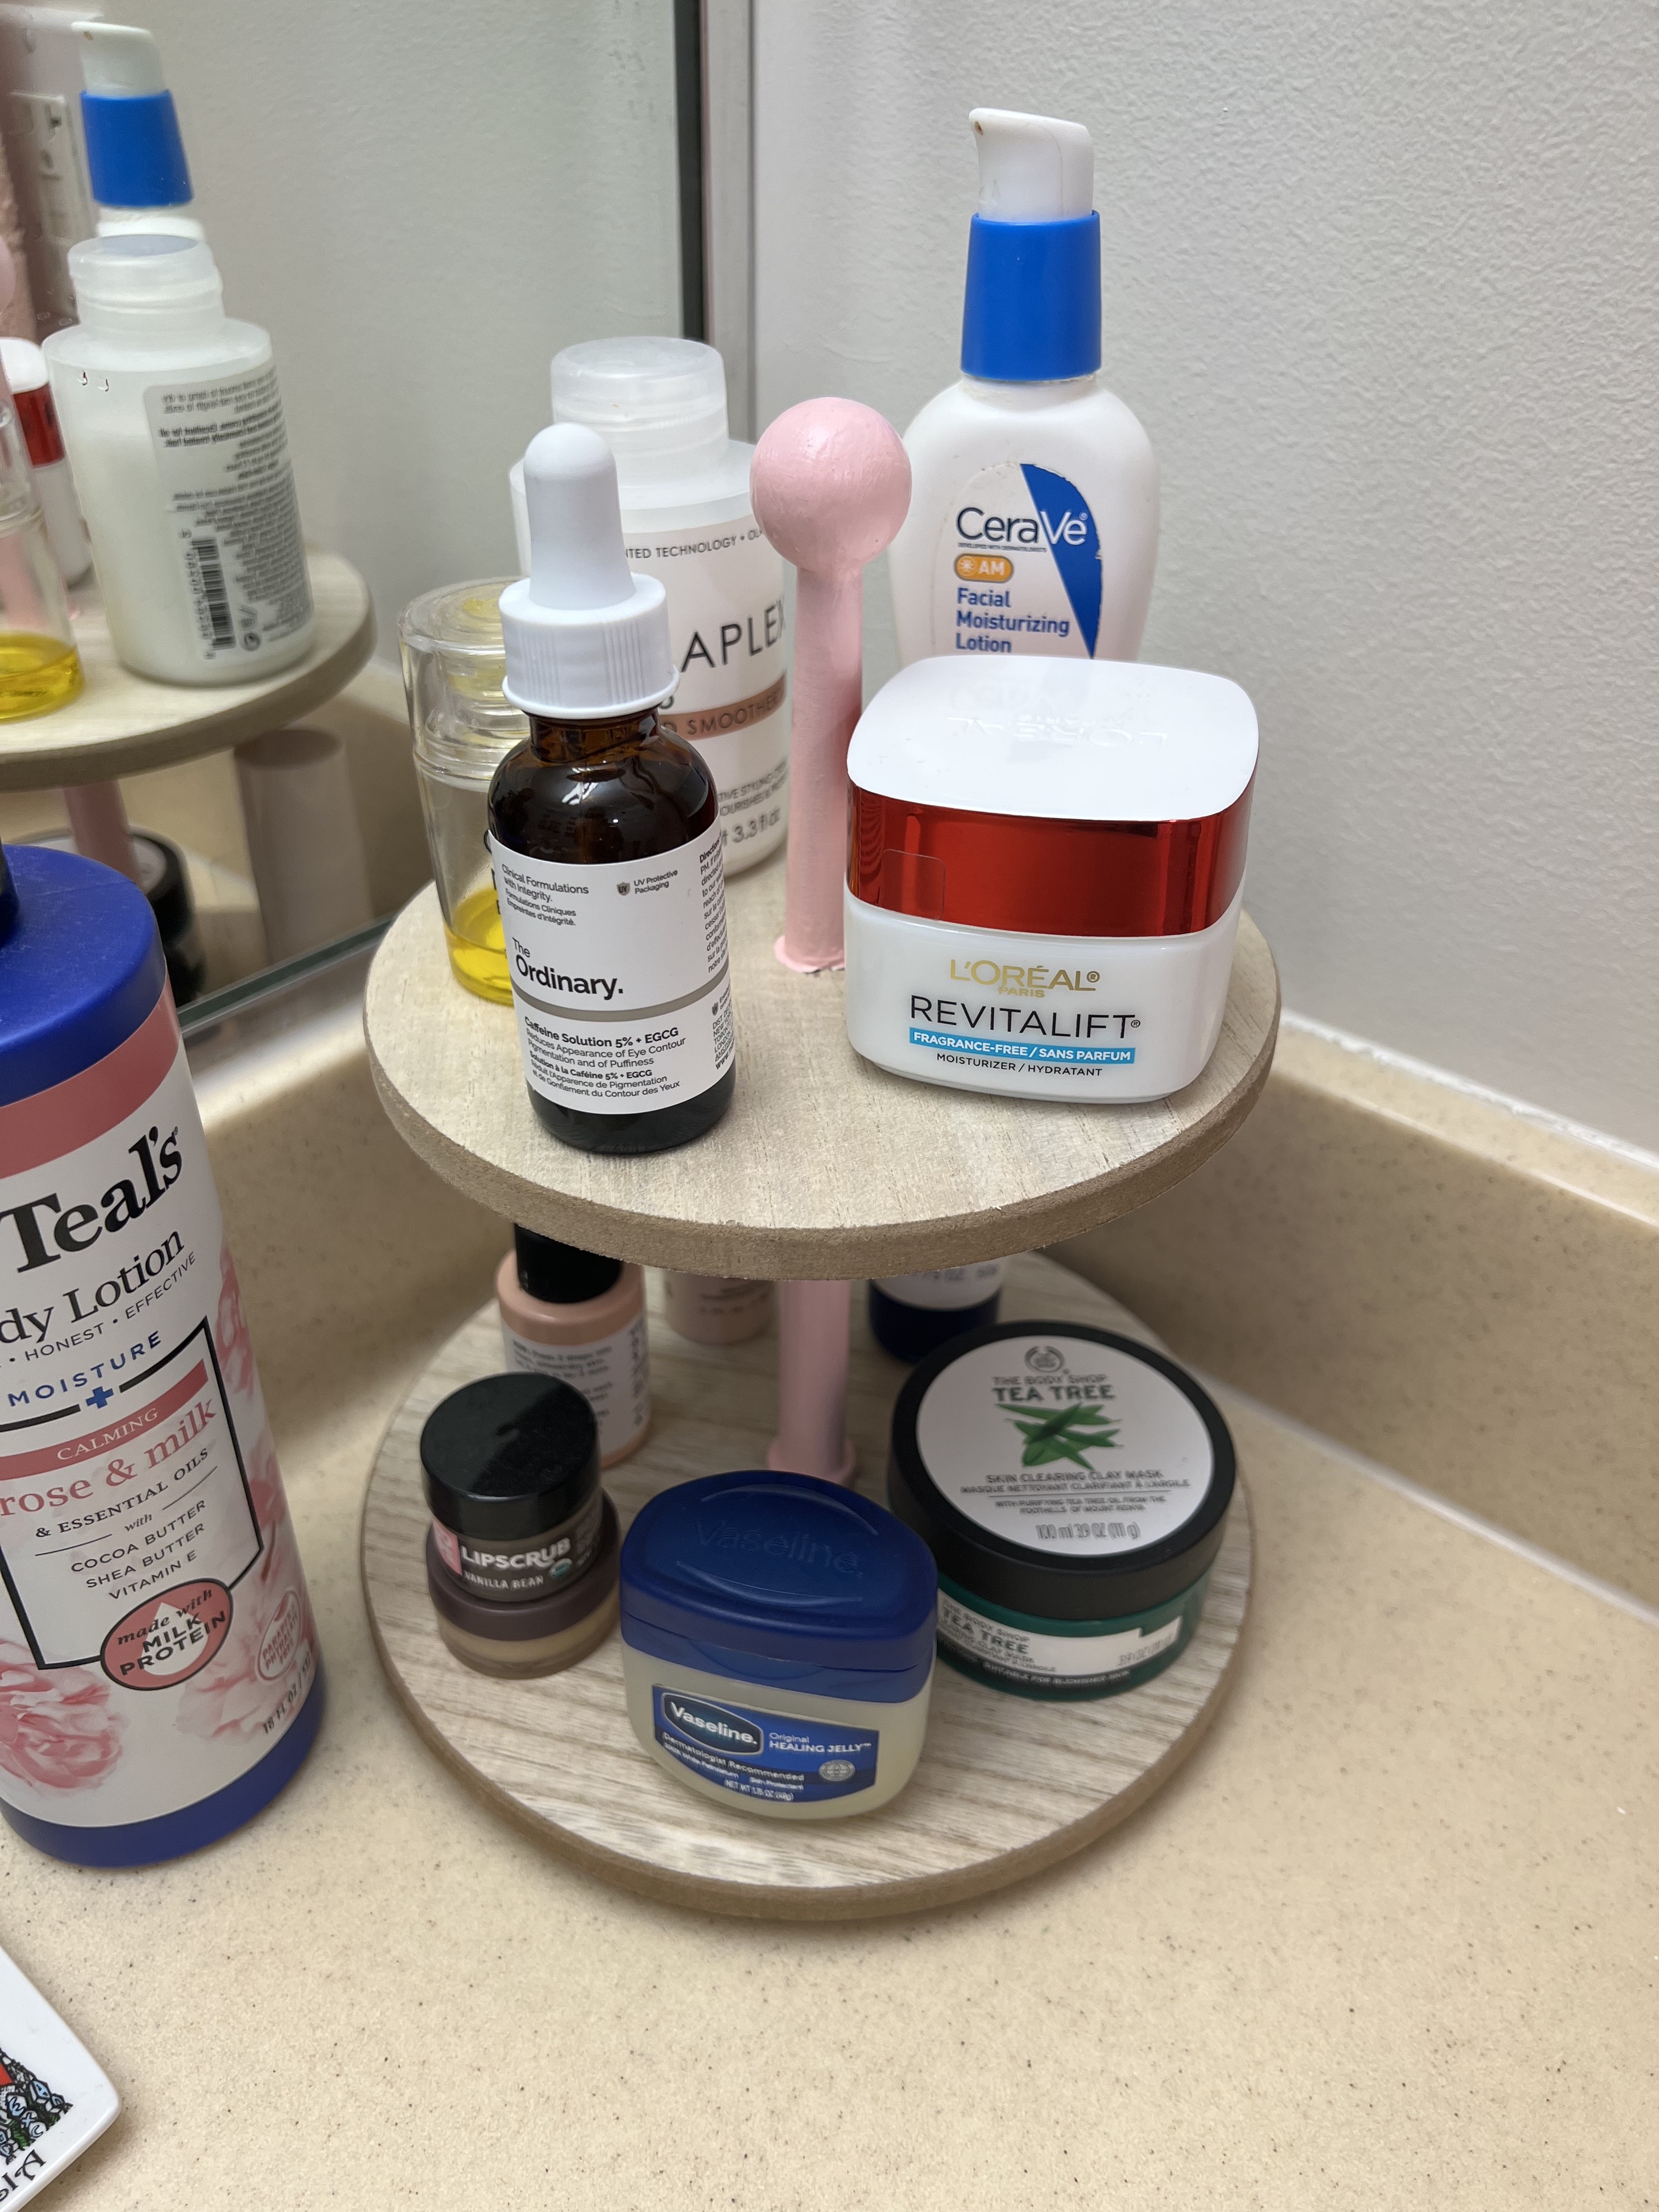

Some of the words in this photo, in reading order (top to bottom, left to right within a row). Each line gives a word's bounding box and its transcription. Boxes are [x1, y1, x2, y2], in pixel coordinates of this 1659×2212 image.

[656, 534, 737, 558] TECHNOLOGY
[978, 560, 1006, 575] AM
[957, 587, 1011, 608] Facial
[956, 610, 1069, 637] Moisturizing
[956, 633, 1011, 653] Lotion
[526, 876, 589, 894] Formulations
[635, 881, 669, 894] Packaging
[646, 870, 678, 884] Protective
[702, 888, 708, 898] to
[541, 905, 577, 917] Cliniques
[512, 936, 531, 958] The
[516, 954, 624, 1001] Ordinary.
[997, 986, 1045, 998] PARIS
[525, 1015, 560, 1040] Caffeine
[561, 1033, 612, 1047] Solution
[616, 1036, 634, 1048] 5%
[644, 1027, 679, 1044] EGCG
[556, 1044, 613, 1058] Appearance
[616, 1049, 626, 1058] of
[628, 1049, 647, 1058] Eye
[648, 1037, 686, 1054] Contour
[913, 1031, 1028, 1057] FRAGRANCE-FREE
[1039, 1048, 1074, 1060] SANS
[1076, 1051, 1131, 1061] PARFUM
[597, 1060, 608, 1068] of
[610, 1058, 654, 1068] Puffiness
[936, 1053, 1016, 1071] MOISTURIZER
[1028, 1064, 1103, 1076] HYDRATANT
[570, 1069, 603, 1079] Caféine
[627, 1070, 652, 1079] EGCG
[610, 1076, 668, 1090] Pigmentation
[659, 1081, 680, 1092] Yeux
[63, 1231, 185, 1323] Lotion
[25, 1322, 104, 1362] HONEST
[125, 1251, 196, 1320] EFFECTIVE
[8, 1331, 161, 1407] MOISTURE
[992, 1375, 1022, 1386] THE
[1068, 1373, 1108, 1384] SHOP
[992, 1386, 1044, 1402] TEA
[1049, 1384, 1115, 1401] TREE
[57, 1407, 159, 1463] CALMING
[0, 1479, 94, 1517] rose
[105, 1458, 138, 1487] &
[144, 1398, 217, 1471] milk
[986, 1474, 1017, 1483] SKIN
[1019, 1471, 1086, 1482] CLEARING
[1088, 1470, 1122, 1481] CLAY
[1125, 1469, 1165, 1480] MASK
[35, 1526, 52, 1539] &
[57, 1481, 169, 1534] ESSENTIAL
[174, 1447, 209, 1481] OILS
[124, 1512, 153, 1533] with
[71, 1543, 139, 1573] COCOA
[144, 1500, 207, 1546] BUTTER
[86, 1565, 134, 1589] SHEA
[142, 1522, 205, 1568] BUTTER
[460, 1537, 571, 1569] LIPSCRUB
[109, 1559, 182, 1601] VITAMIN
[187, 1549, 198, 1562] E
[463, 1570, 509, 1589] VANILLA
[511, 1575, 544, 1590] BEAN
[116, 1615, 171, 1646] made
[175, 1588, 213, 1618] with
[142, 1612, 202, 1652] MILK
[943, 1607, 975, 1635] TEA
[981, 1629, 1030, 1655] TREE
[119, 1611, 227, 1676] PROTEIN
[769, 1732, 810, 1743] Original
[769, 1740, 825, 1753] HEALING
[663, 1731, 727, 1765] Dermatologist
[727, 1760, 805, 1781] Recommended
[725, 1779, 739, 1789] NET
